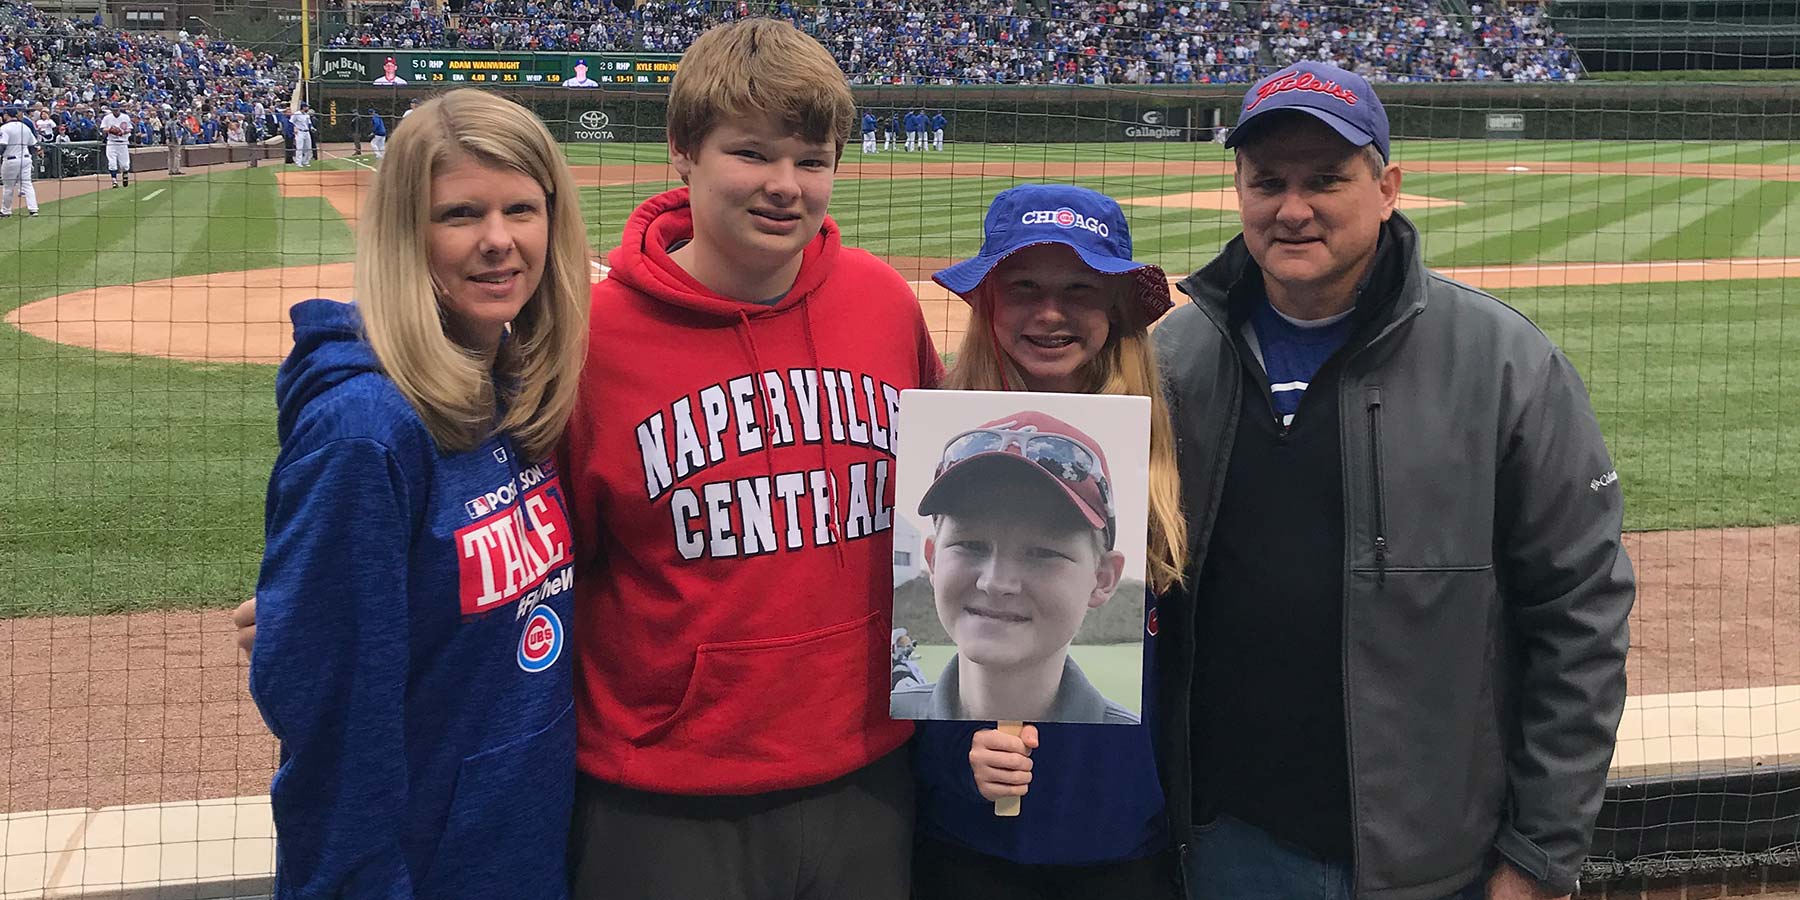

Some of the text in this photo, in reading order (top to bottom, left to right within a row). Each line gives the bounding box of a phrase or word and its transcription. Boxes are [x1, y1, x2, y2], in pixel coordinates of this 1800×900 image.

[322, 57, 366, 76] JIM BEAM
[428, 60, 444, 68] RHP
[449, 61, 471, 69] ADAM
[472, 61, 520, 70] WAINWRIGHT
[615, 62, 631, 71] RHP
[636, 63, 653, 71] KYLE
[653, 63, 680, 72] HENDRI
[1246, 71, 1359, 111] Titleist
[574, 130, 615, 140] TOYOTA
[1125, 126, 1182, 139] Gallagher
[1021, 207, 1109, 238] CHICAGO
[635, 366, 901, 502] NAPERVILLE
[670, 458, 893, 561] CENTRAL
[461, 493, 564, 607] TAKE
